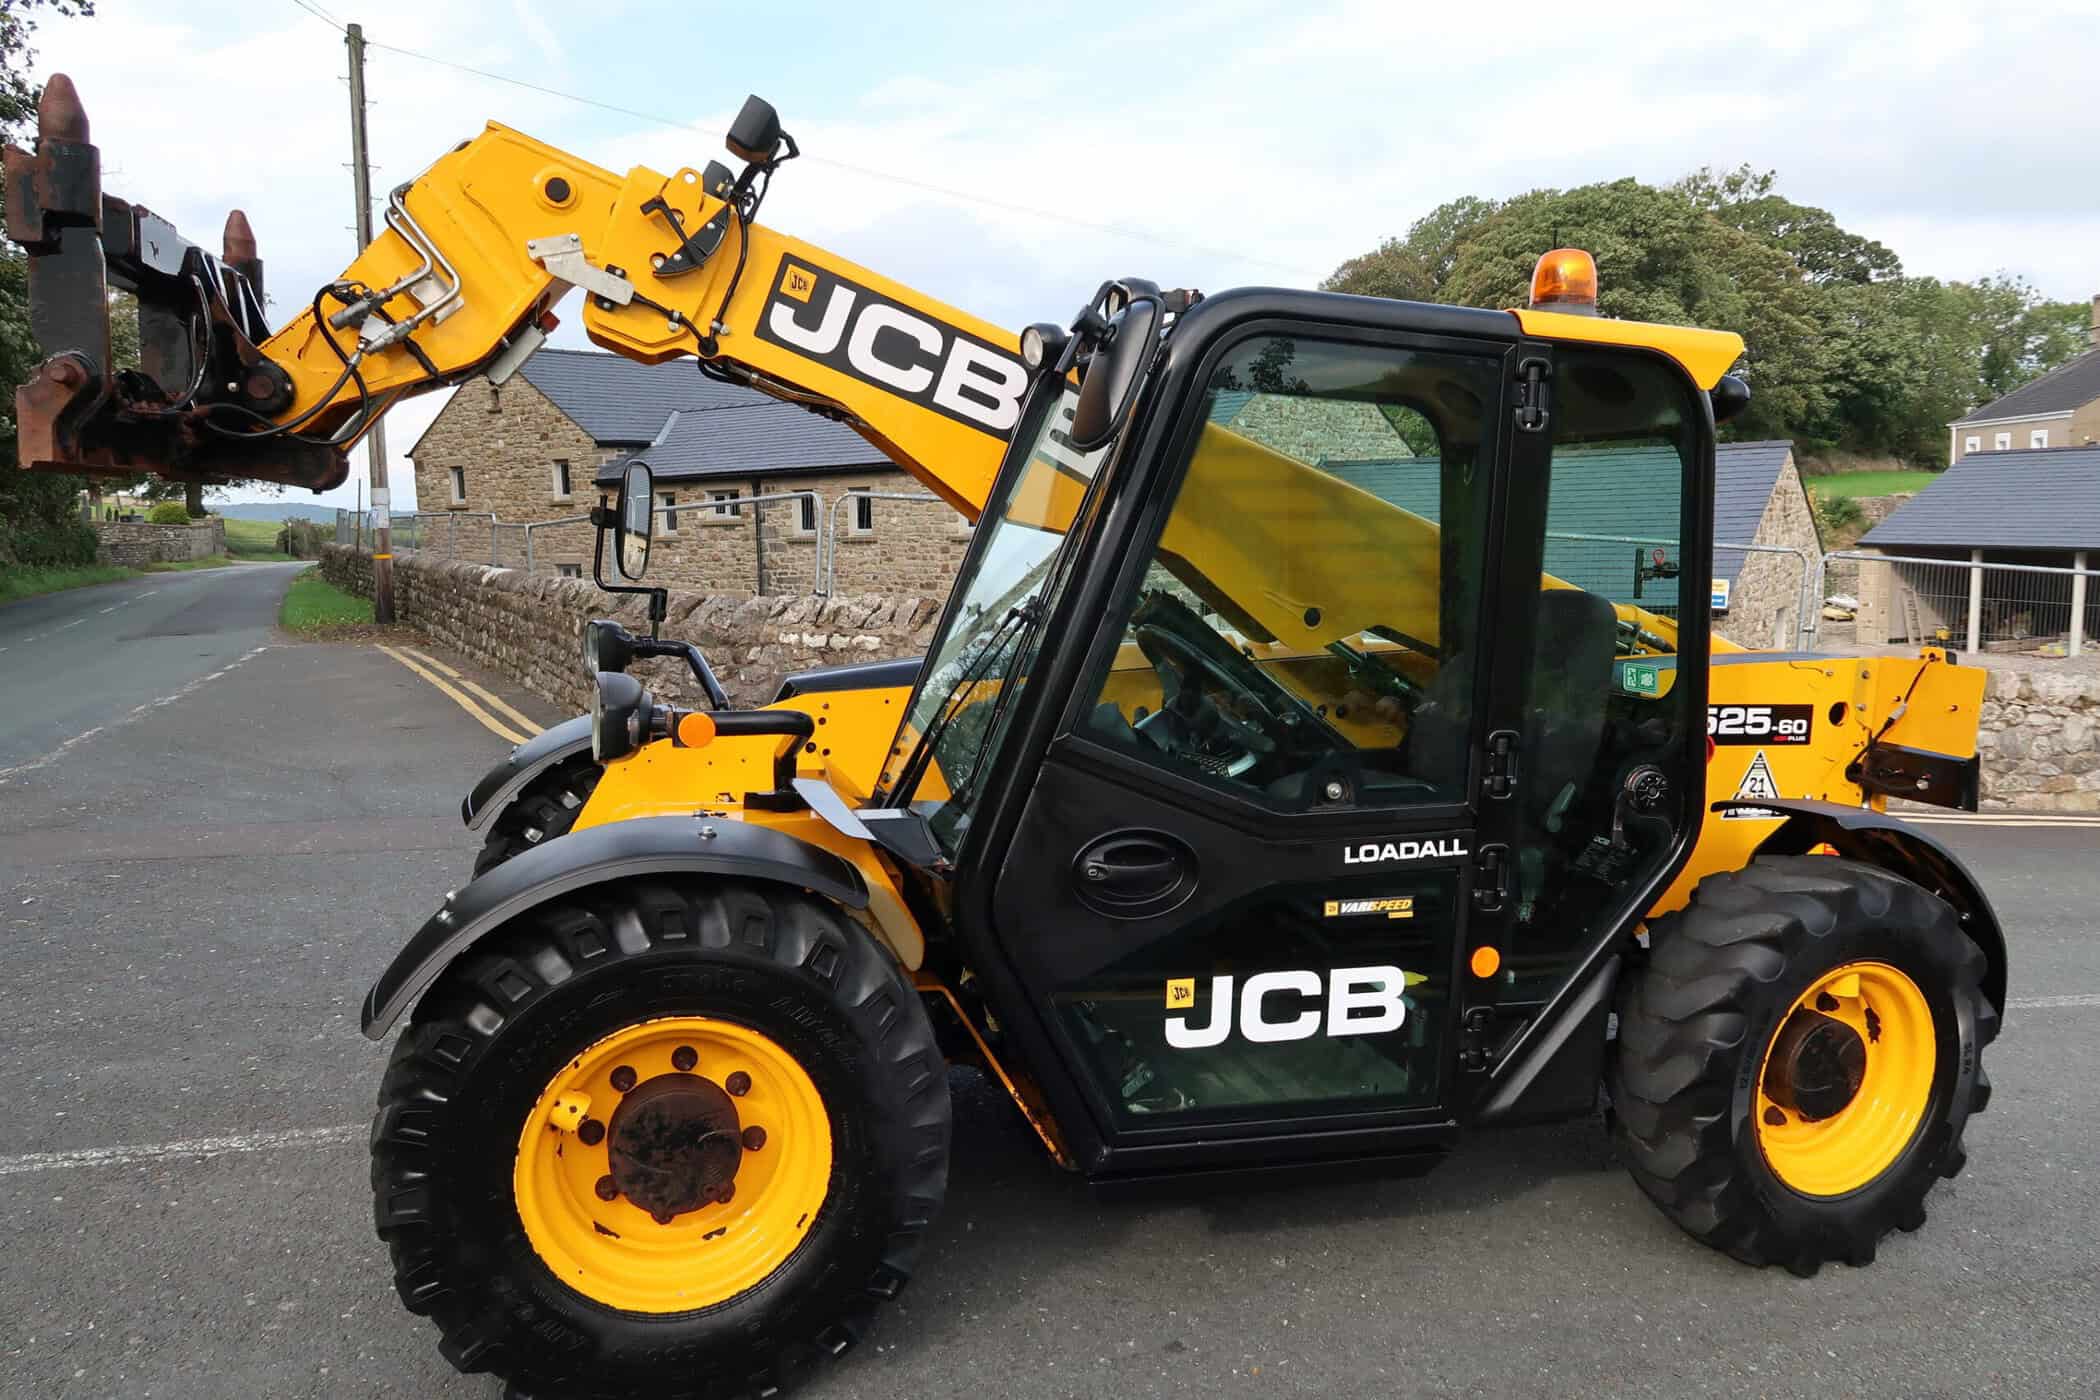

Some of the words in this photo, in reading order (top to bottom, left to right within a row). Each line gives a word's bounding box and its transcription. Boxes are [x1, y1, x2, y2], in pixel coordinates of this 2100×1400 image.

[769, 285, 1029, 430] JCB
[1749, 777, 1766, 793] 21
[1344, 838, 1468, 864] LOADALL
[1165, 966, 1406, 1048] JCB
